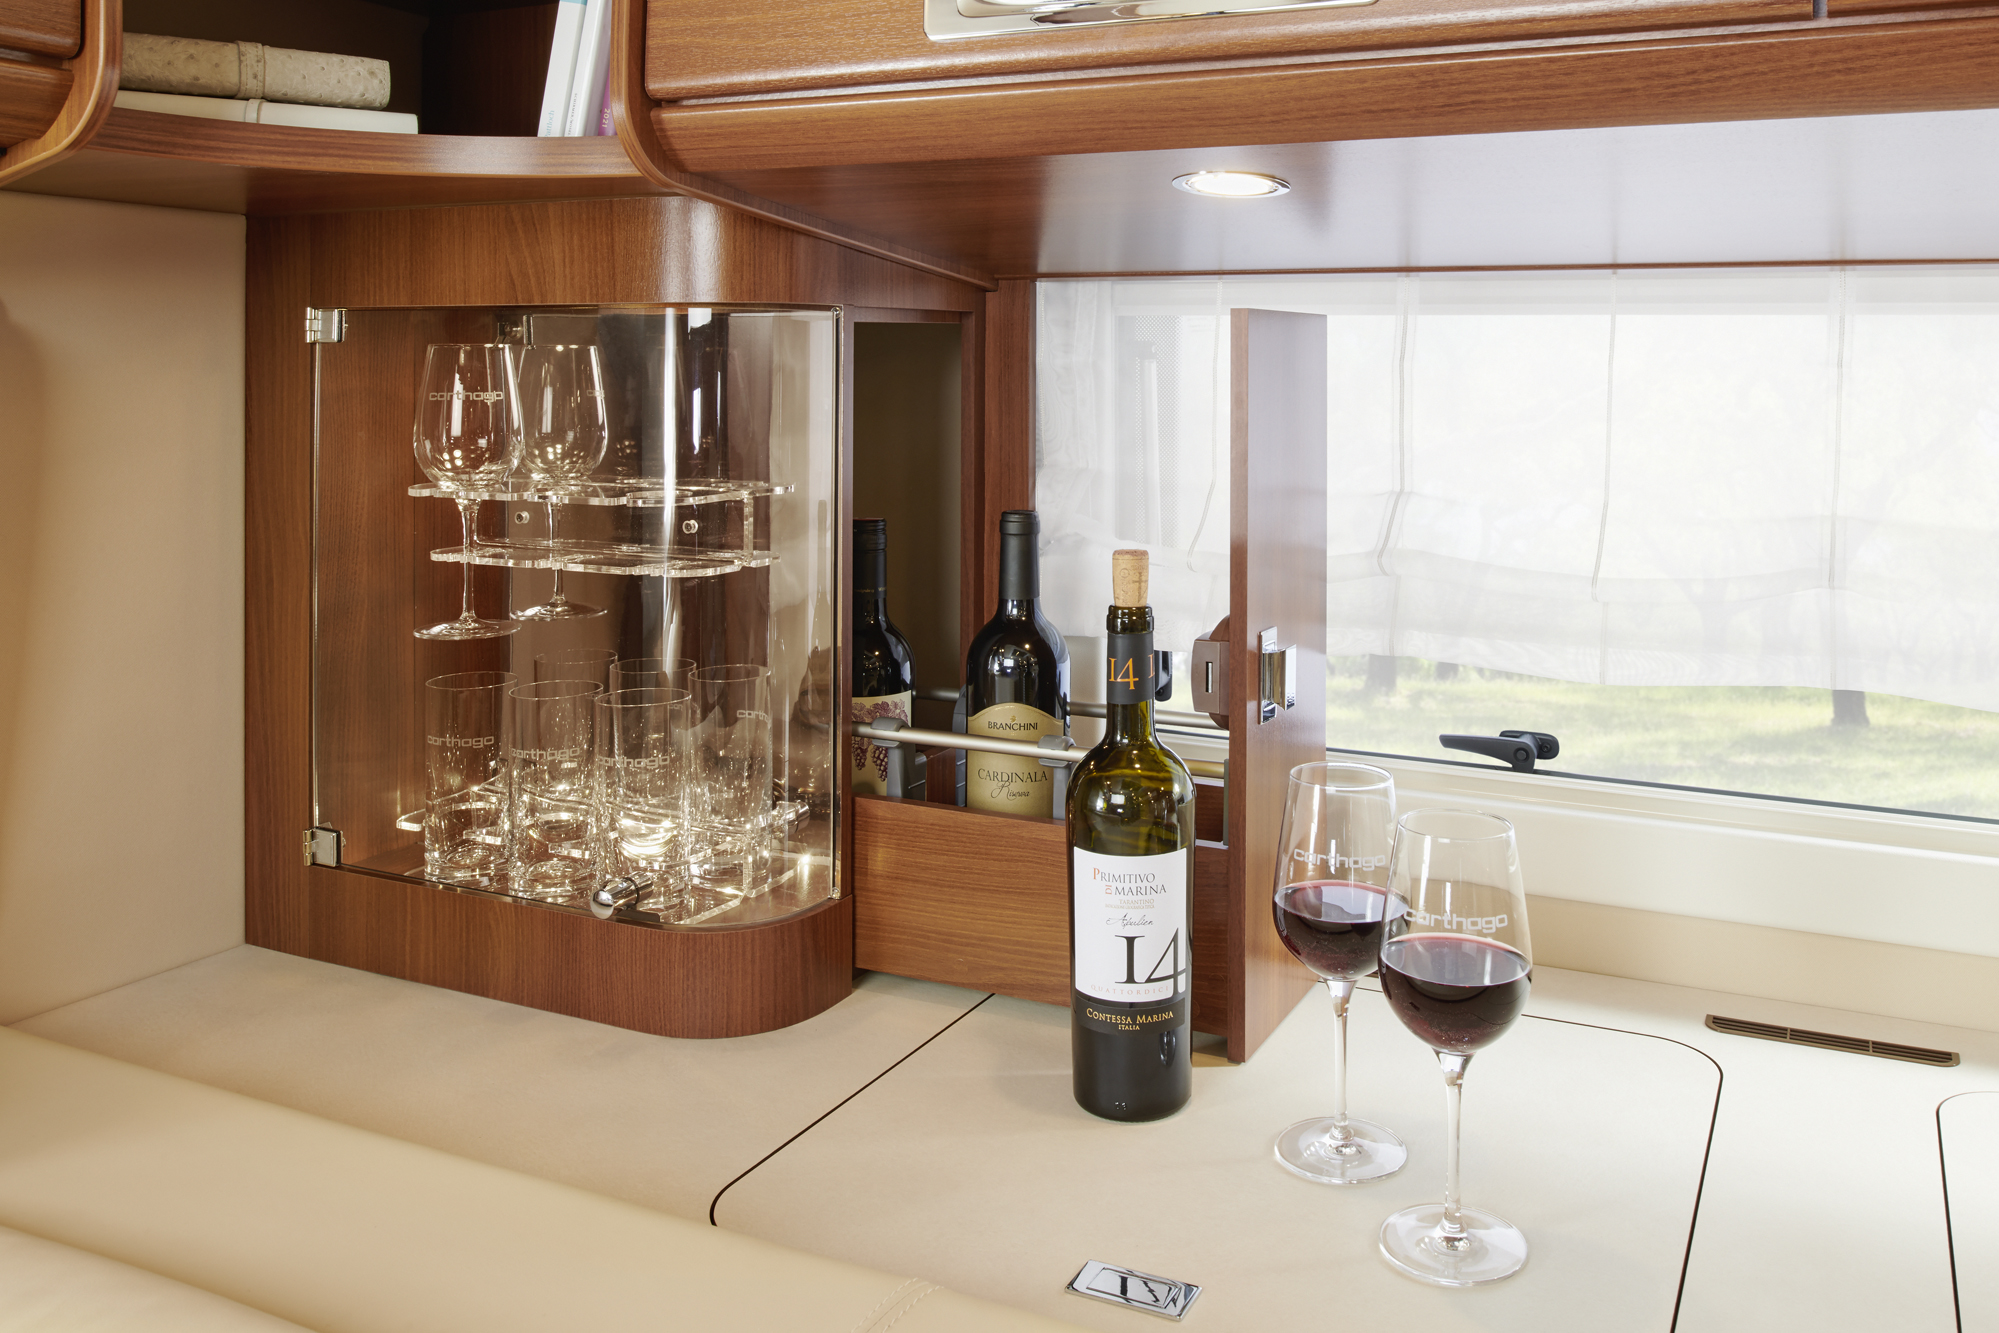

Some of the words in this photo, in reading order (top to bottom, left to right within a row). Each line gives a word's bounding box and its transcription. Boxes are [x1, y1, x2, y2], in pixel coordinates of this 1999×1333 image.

[602, 108, 611, 128] 2021
[429, 390, 503, 403] carthago
[1108, 657, 1139, 690] 14
[987, 721, 1038, 731] BRANCHINI
[427, 735, 494, 748] carthago
[511, 747, 580, 760] carthago
[597, 755, 670, 768] carthago
[978, 768, 1048, 783] CARDINALA
[1293, 849, 1386, 871] carthago
[1093, 867, 1156, 884] PRIMITIVO
[1114, 884, 1167, 896] MARINA
[1404, 908, 1508, 934] carthago
[1114, 927, 1186, 996] 14
[1090, 984, 1169, 996] QUATTORDICI
[1086, 1007, 1132, 1024] CONTESSA
[1136, 1010, 1174, 1024] MARINA
